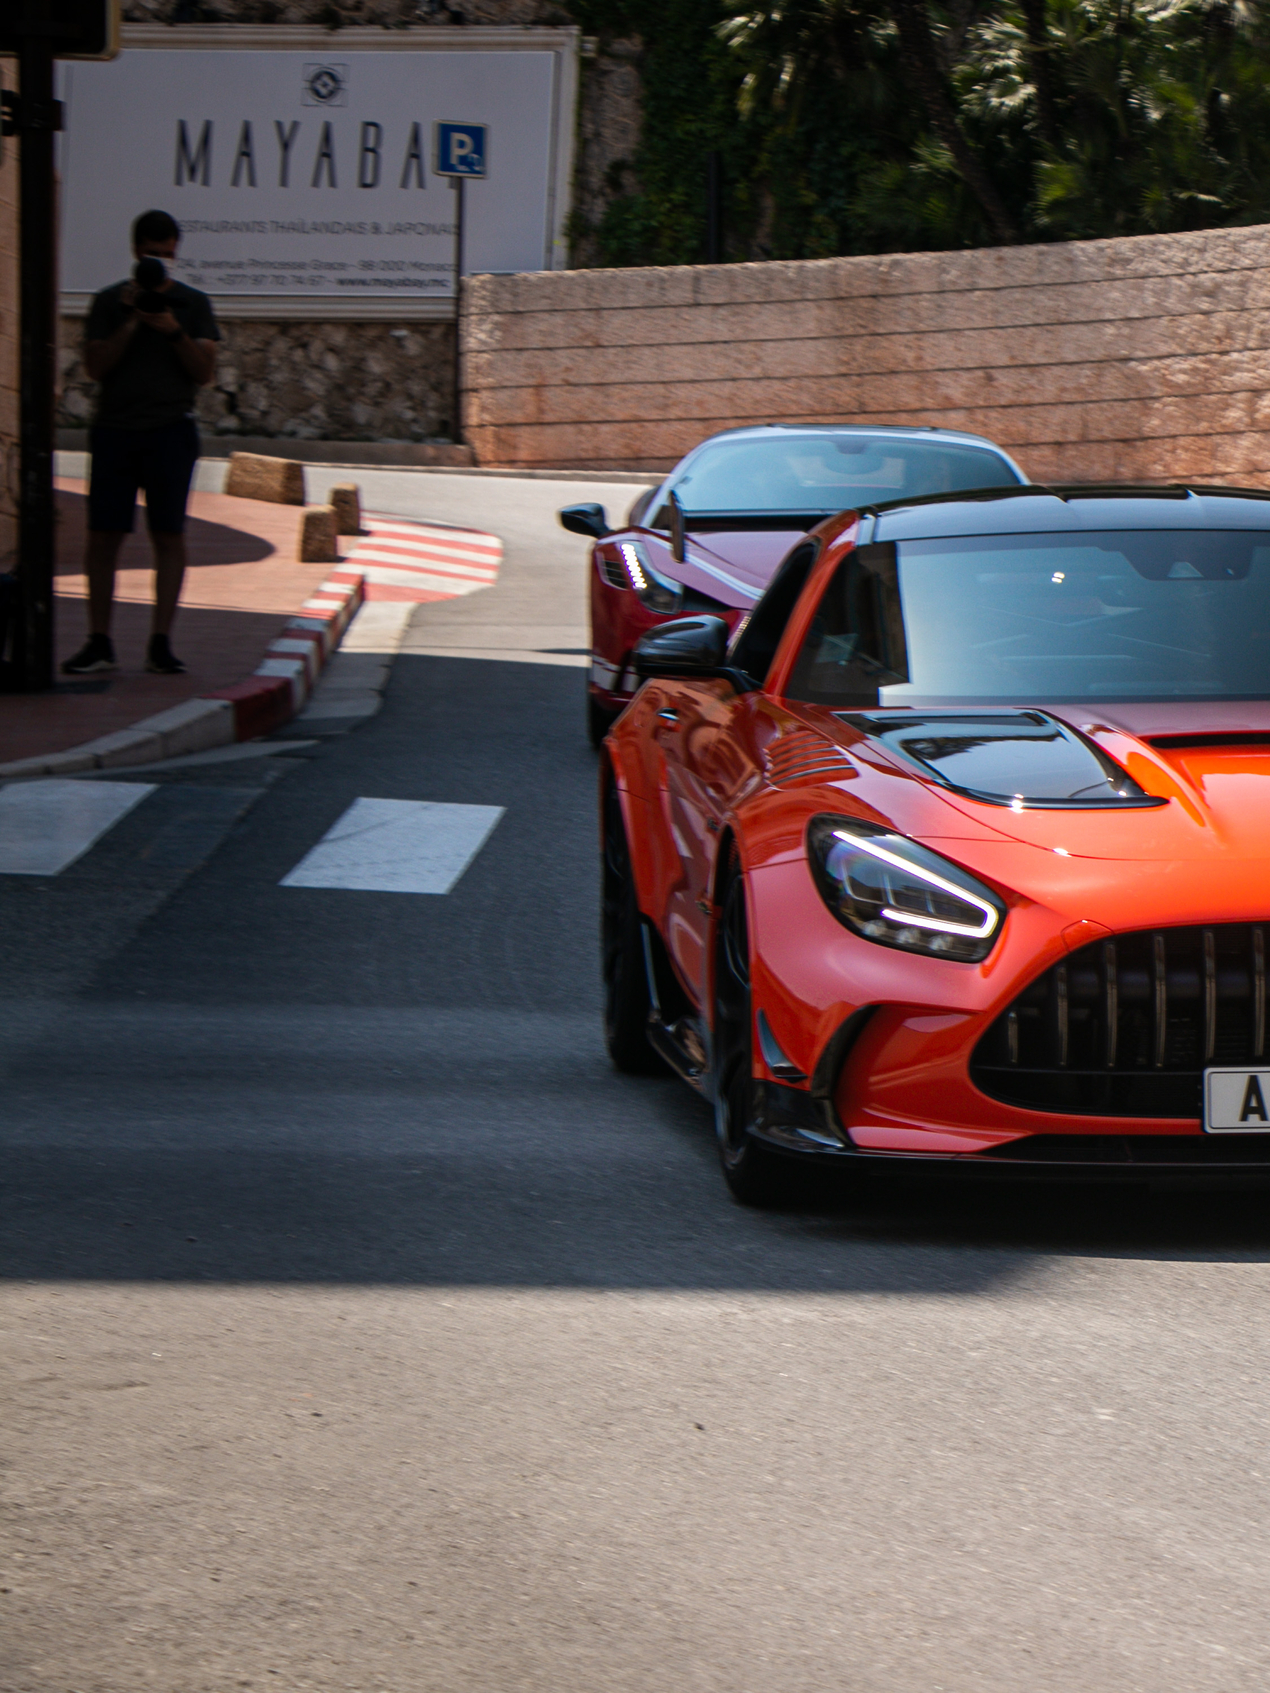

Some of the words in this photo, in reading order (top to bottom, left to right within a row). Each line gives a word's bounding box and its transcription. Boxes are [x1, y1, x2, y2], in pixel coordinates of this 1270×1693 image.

[174, 119, 458, 189] MAYABA
[450, 132, 474, 165] P
[178, 220, 268, 233] ESTAURANTS
[371, 221, 382, 235] &
[247, 258, 308, 270] Princesse
